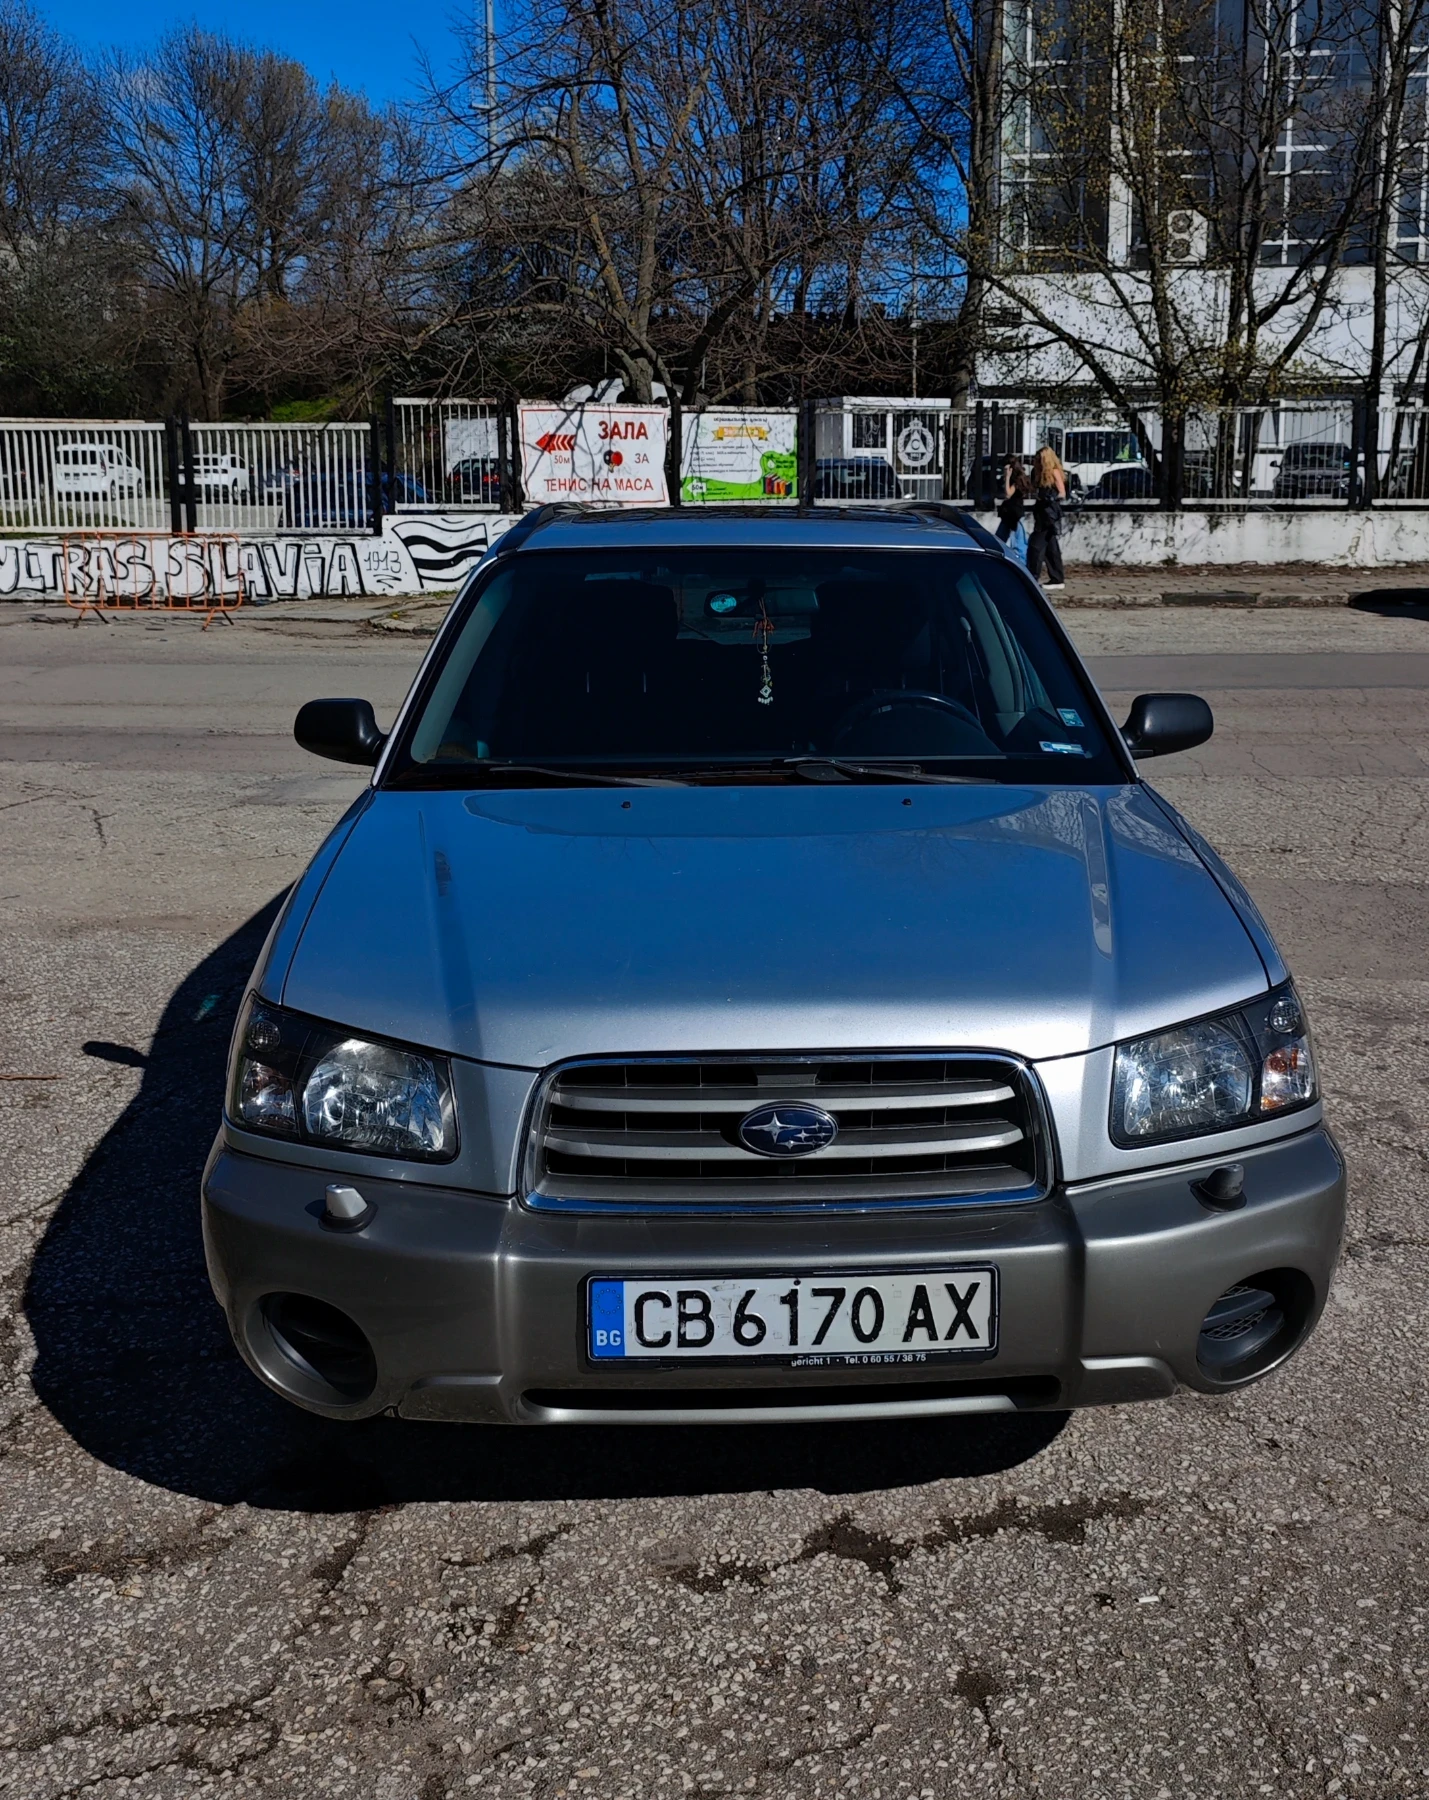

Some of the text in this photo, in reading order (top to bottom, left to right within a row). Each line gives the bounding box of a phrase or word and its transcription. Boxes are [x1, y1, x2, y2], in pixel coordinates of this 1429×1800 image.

[598, 420, 649, 440] ЗАЛА
[554, 455, 570, 464] 50м
[634, 453, 649, 464] ЗА
[544, 478, 654, 492] ТЕНИС НА МАСА
[363, 550, 402, 574] 1913
[634, 1281, 981, 1348] CB 6170 AX
[596, 1330, 622, 1347] BG
[844, 1356, 860, 1364] Tel.
